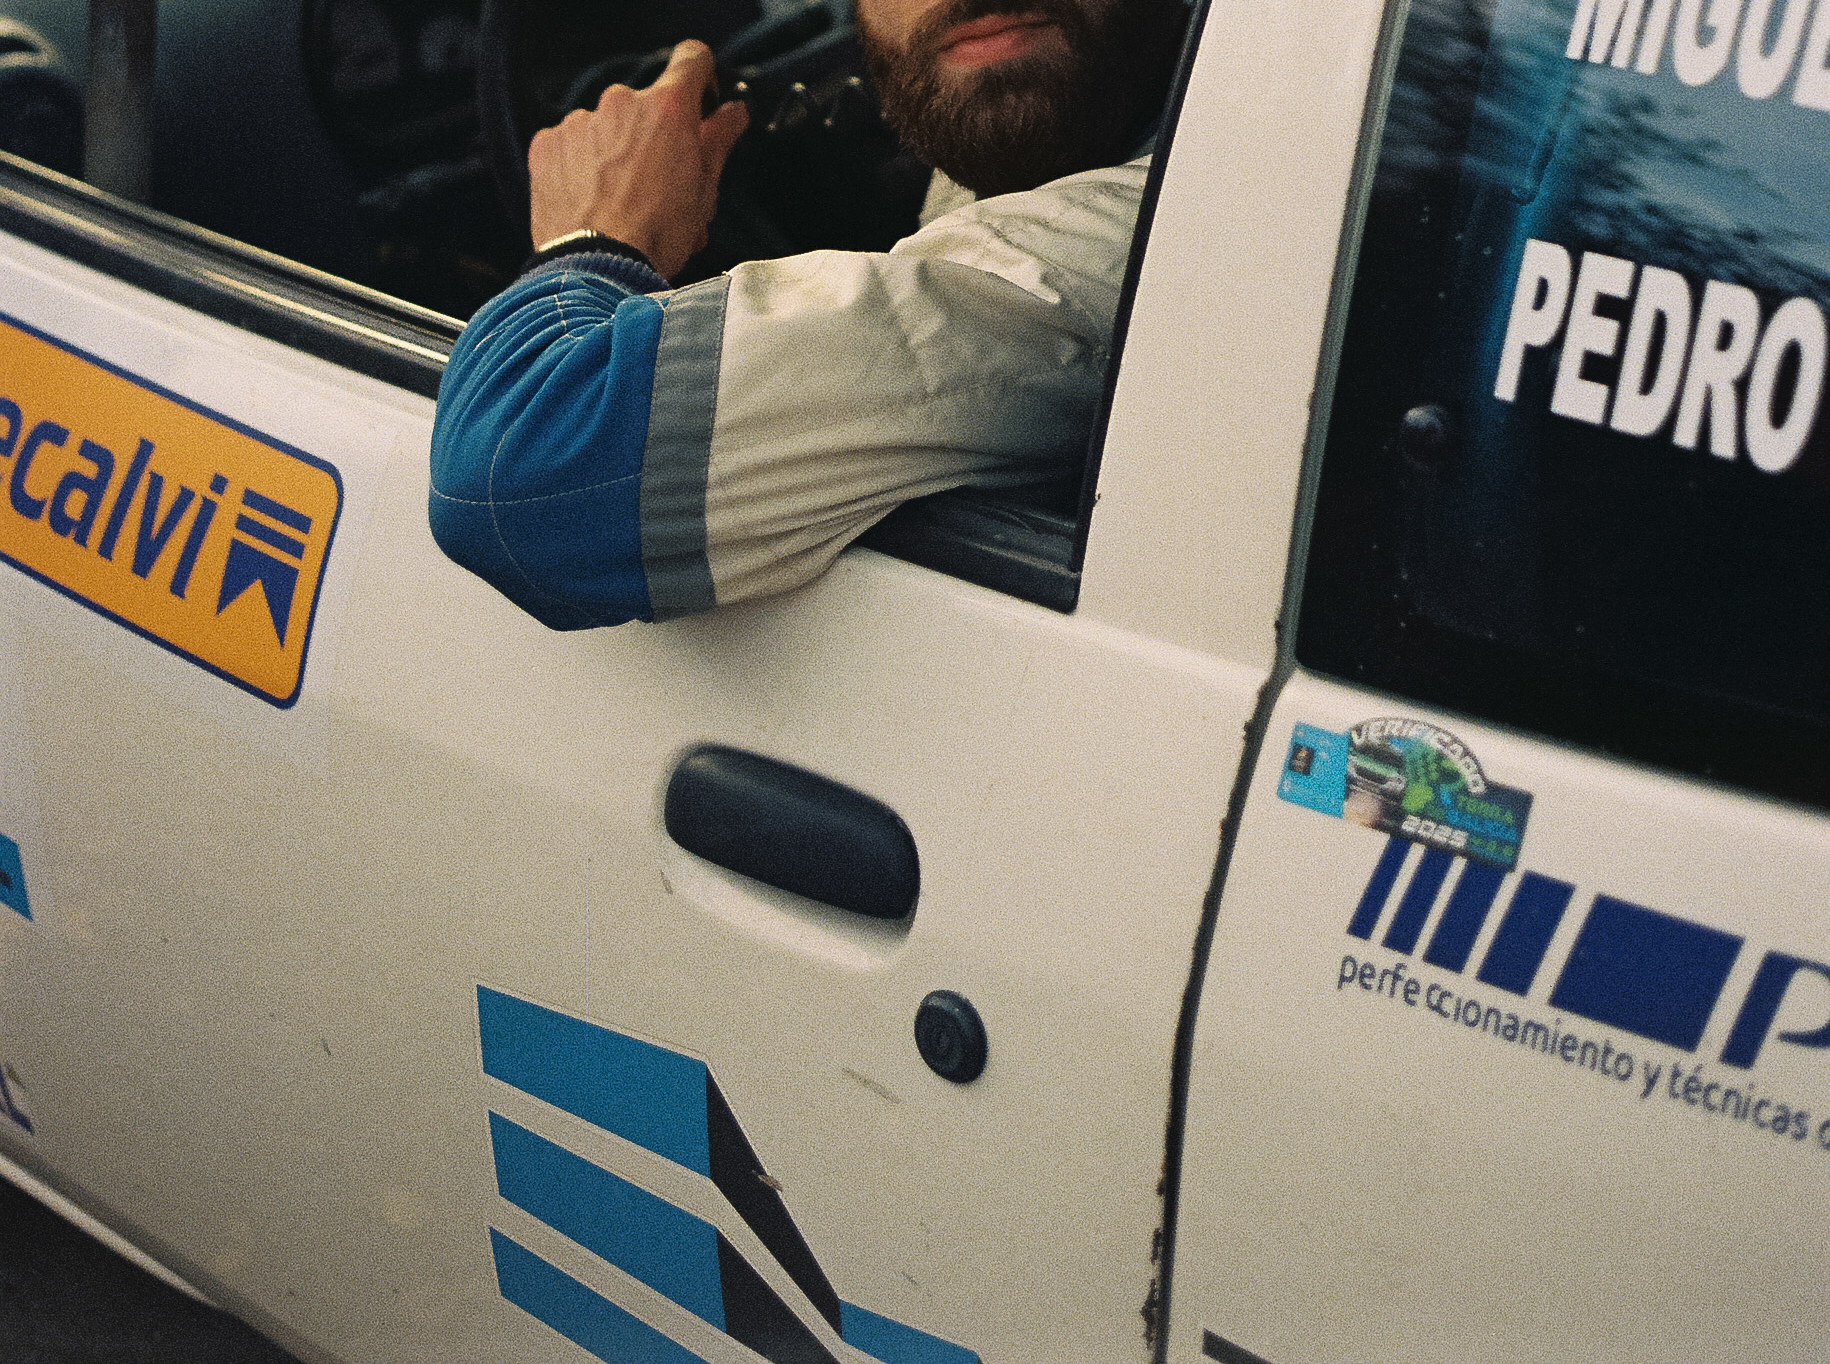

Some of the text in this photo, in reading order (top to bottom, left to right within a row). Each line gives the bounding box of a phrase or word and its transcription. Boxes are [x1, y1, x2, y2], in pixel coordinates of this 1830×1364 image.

[1494, 238, 1829, 475] PEDRO
[1401, 814, 1469, 850] 2025
[1337, 954, 1634, 1083] perfeccionamiento
[1640, 1058, 1662, 1100] y
[1668, 1062, 1810, 1143] técnicas
